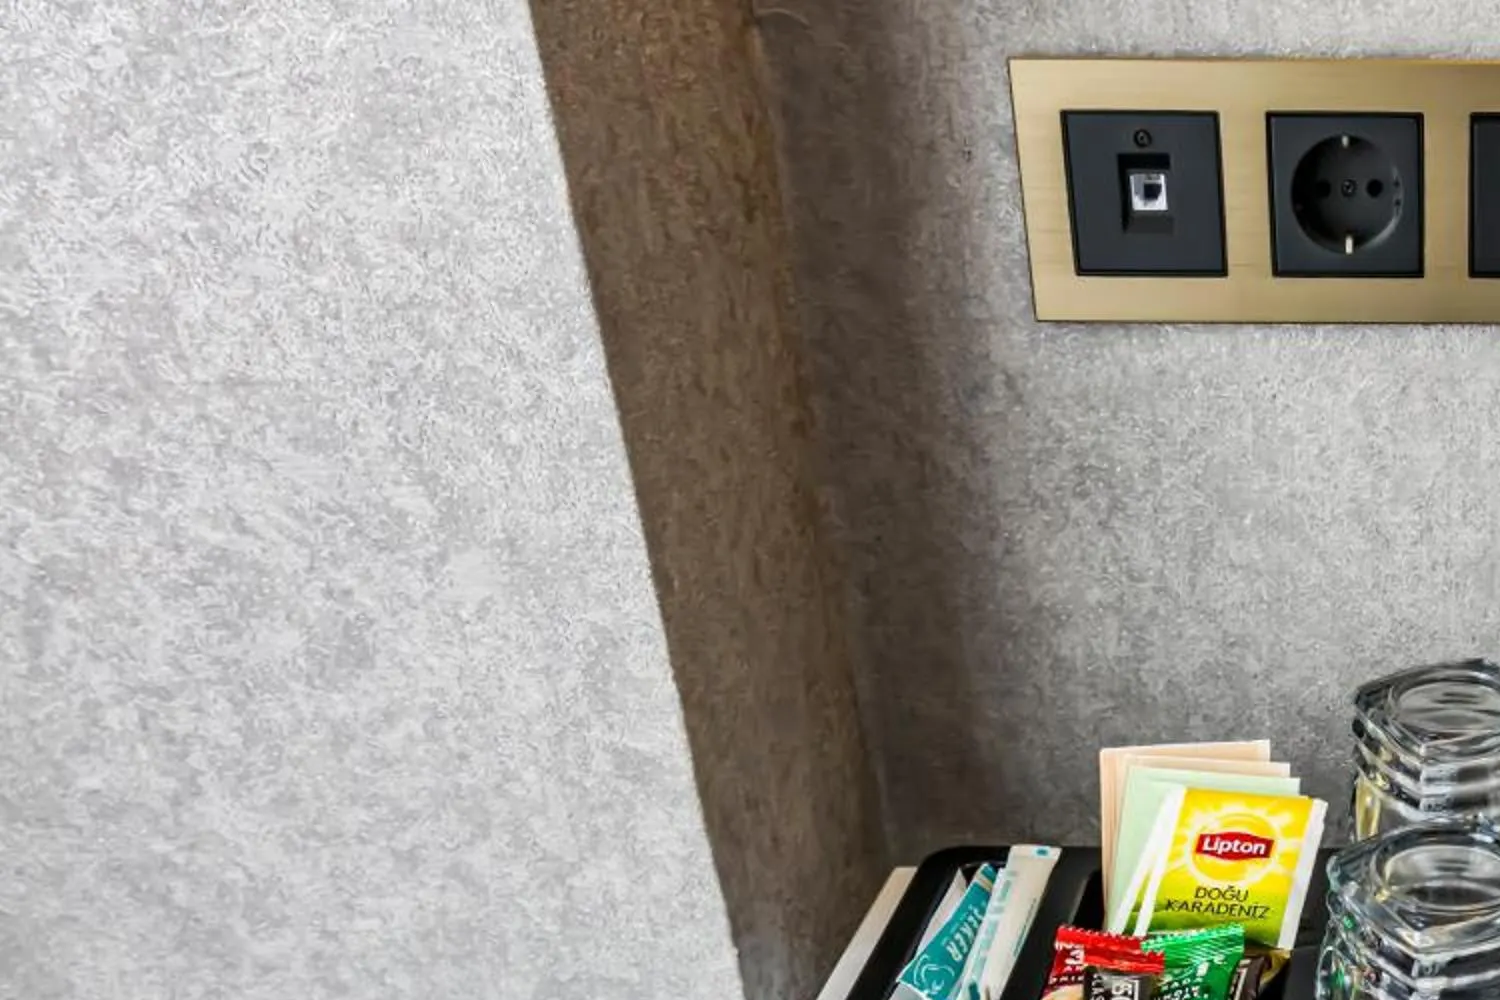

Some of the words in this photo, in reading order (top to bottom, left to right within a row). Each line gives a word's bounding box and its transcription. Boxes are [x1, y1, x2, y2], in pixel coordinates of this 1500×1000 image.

[1202, 836, 1267, 855] Lipton
[1194, 885, 1249, 901] DOĞU
[1165, 899, 1271, 919] KARADENİZ
